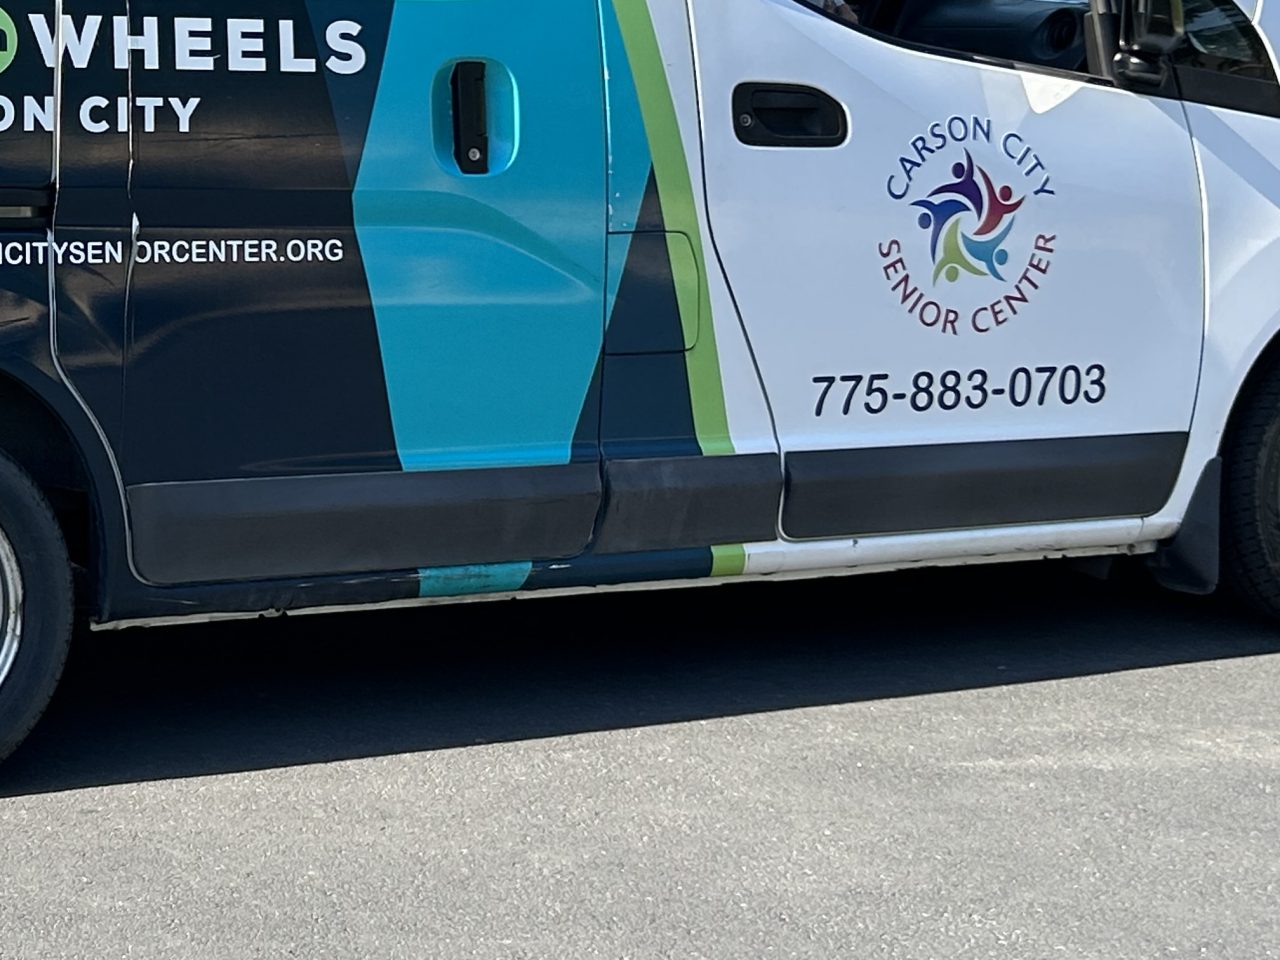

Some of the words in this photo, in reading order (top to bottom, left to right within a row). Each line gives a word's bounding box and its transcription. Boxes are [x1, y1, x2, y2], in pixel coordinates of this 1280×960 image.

[27, 13, 367, 75] WHEELS
[78, 95, 202, 134] CITY
[885, 115, 992, 201] CARSON
[1001, 132, 1057, 199] CITY
[877, 238, 960, 337] SENIOR
[970, 233, 1058, 335] CENTER
[811, 362, 1107, 418] 775-883-0703
